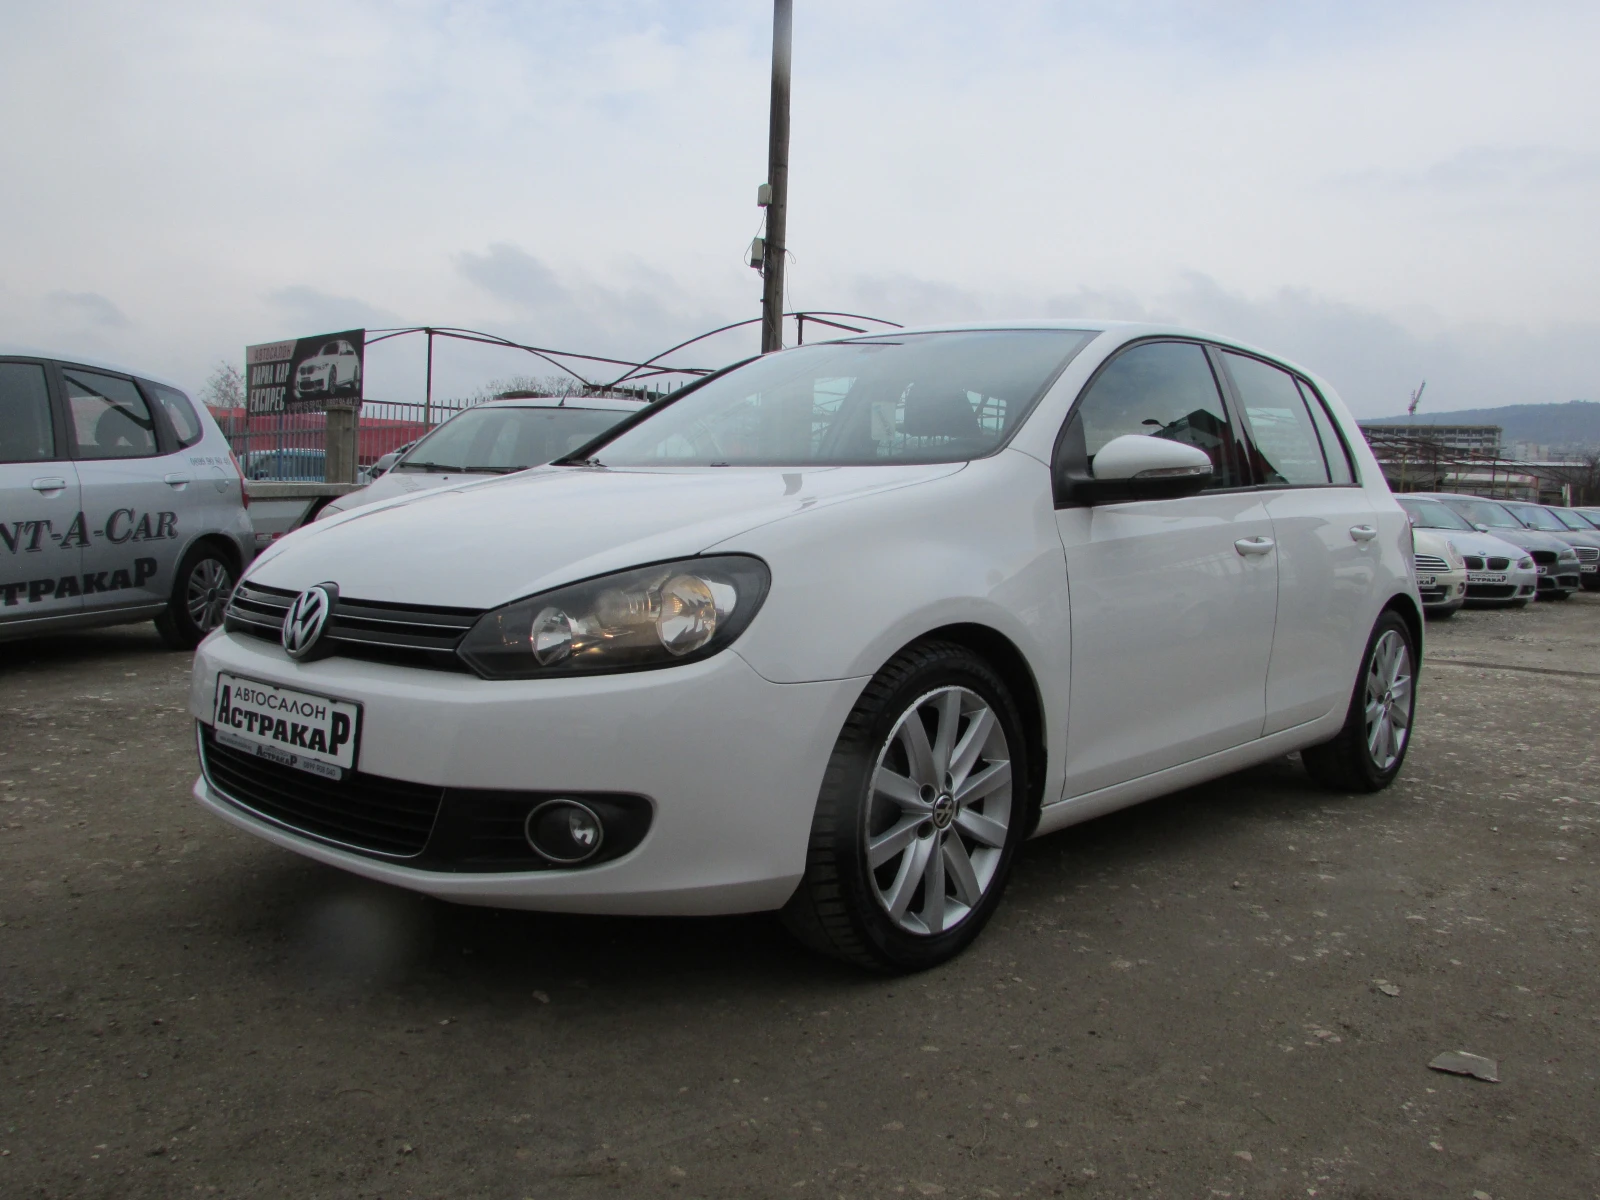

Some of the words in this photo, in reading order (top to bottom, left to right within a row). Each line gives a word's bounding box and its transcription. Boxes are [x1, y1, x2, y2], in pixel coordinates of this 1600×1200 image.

[255, 345, 291, 362] АВТОСАЛОН
[252, 364, 273, 385] ВАРНА
[275, 362, 290, 383] КАР
[249, 386, 286, 412] ЕКСПРЕС
[234, 686, 326, 721] АВТОСАЛОН
[217, 684, 350, 756] АСТРАКАР
[256, 745, 298, 767] АСТРАКАР
